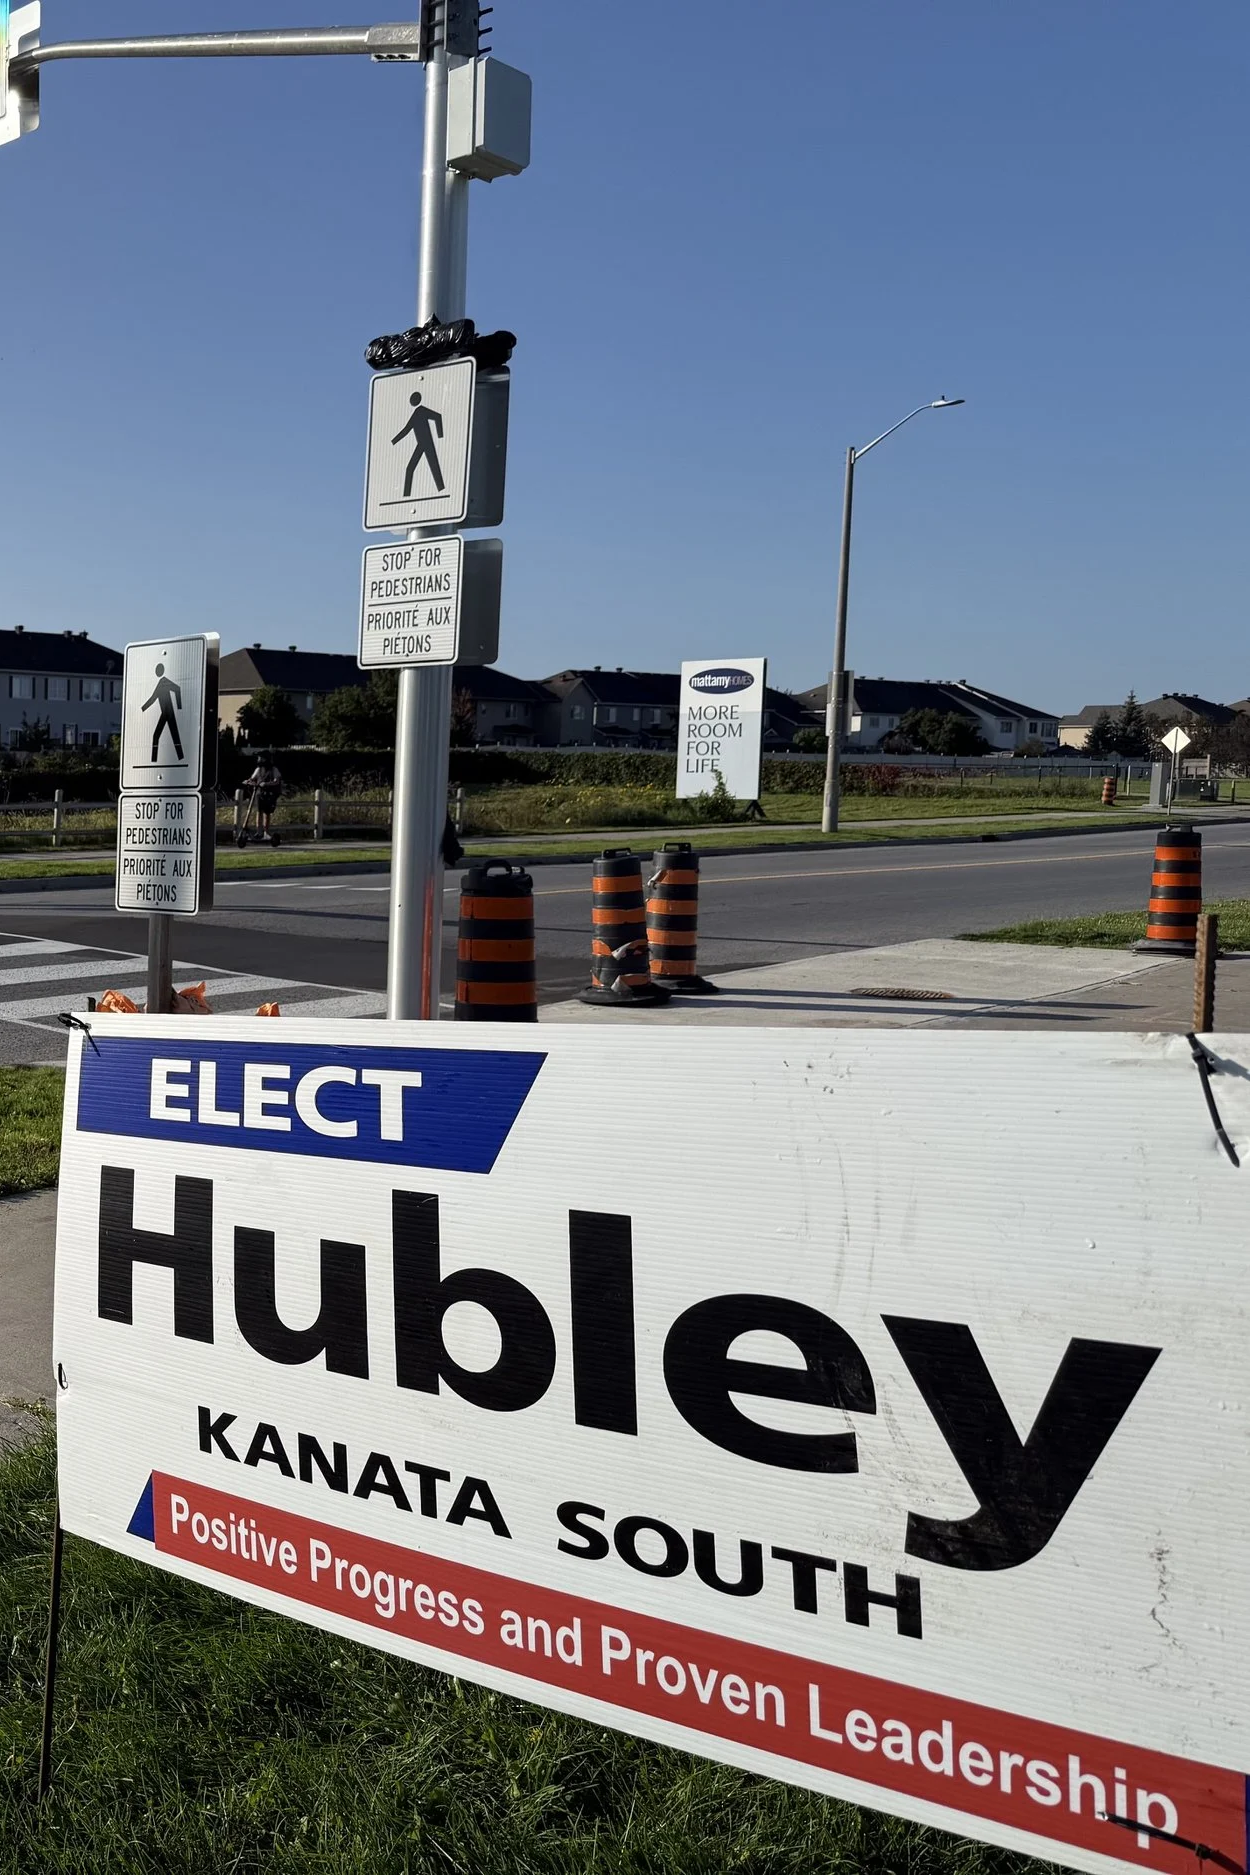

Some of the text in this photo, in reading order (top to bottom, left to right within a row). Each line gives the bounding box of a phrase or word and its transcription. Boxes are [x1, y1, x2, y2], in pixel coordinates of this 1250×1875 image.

[381, 547, 441, 572] STOP FOR
[370, 573, 451, 599] PEDESTRIANS
[367, 604, 452, 631] PRIORITÉ AUX
[382, 631, 432, 655] PIÉTONS
[688, 705, 740, 720] MORE
[687, 722, 743, 738] ROOM
[686, 741, 721, 756] FOR
[686, 758, 721, 773] LIFE
[135, 802, 184, 820] STOP FOR
[125, 827, 192, 846] PEDESTRIANS
[123, 854, 192, 878] PRIORITÉ AUX
[136, 880, 177, 902] PIÉTONS
[149, 1057, 423, 1142] ELECT
[97, 1164, 1163, 1572] Hubley
[196, 1405, 923, 1640] KANATA SOUTH
[169, 1493, 1179, 1849] Positive Progress and Proven Leadership
